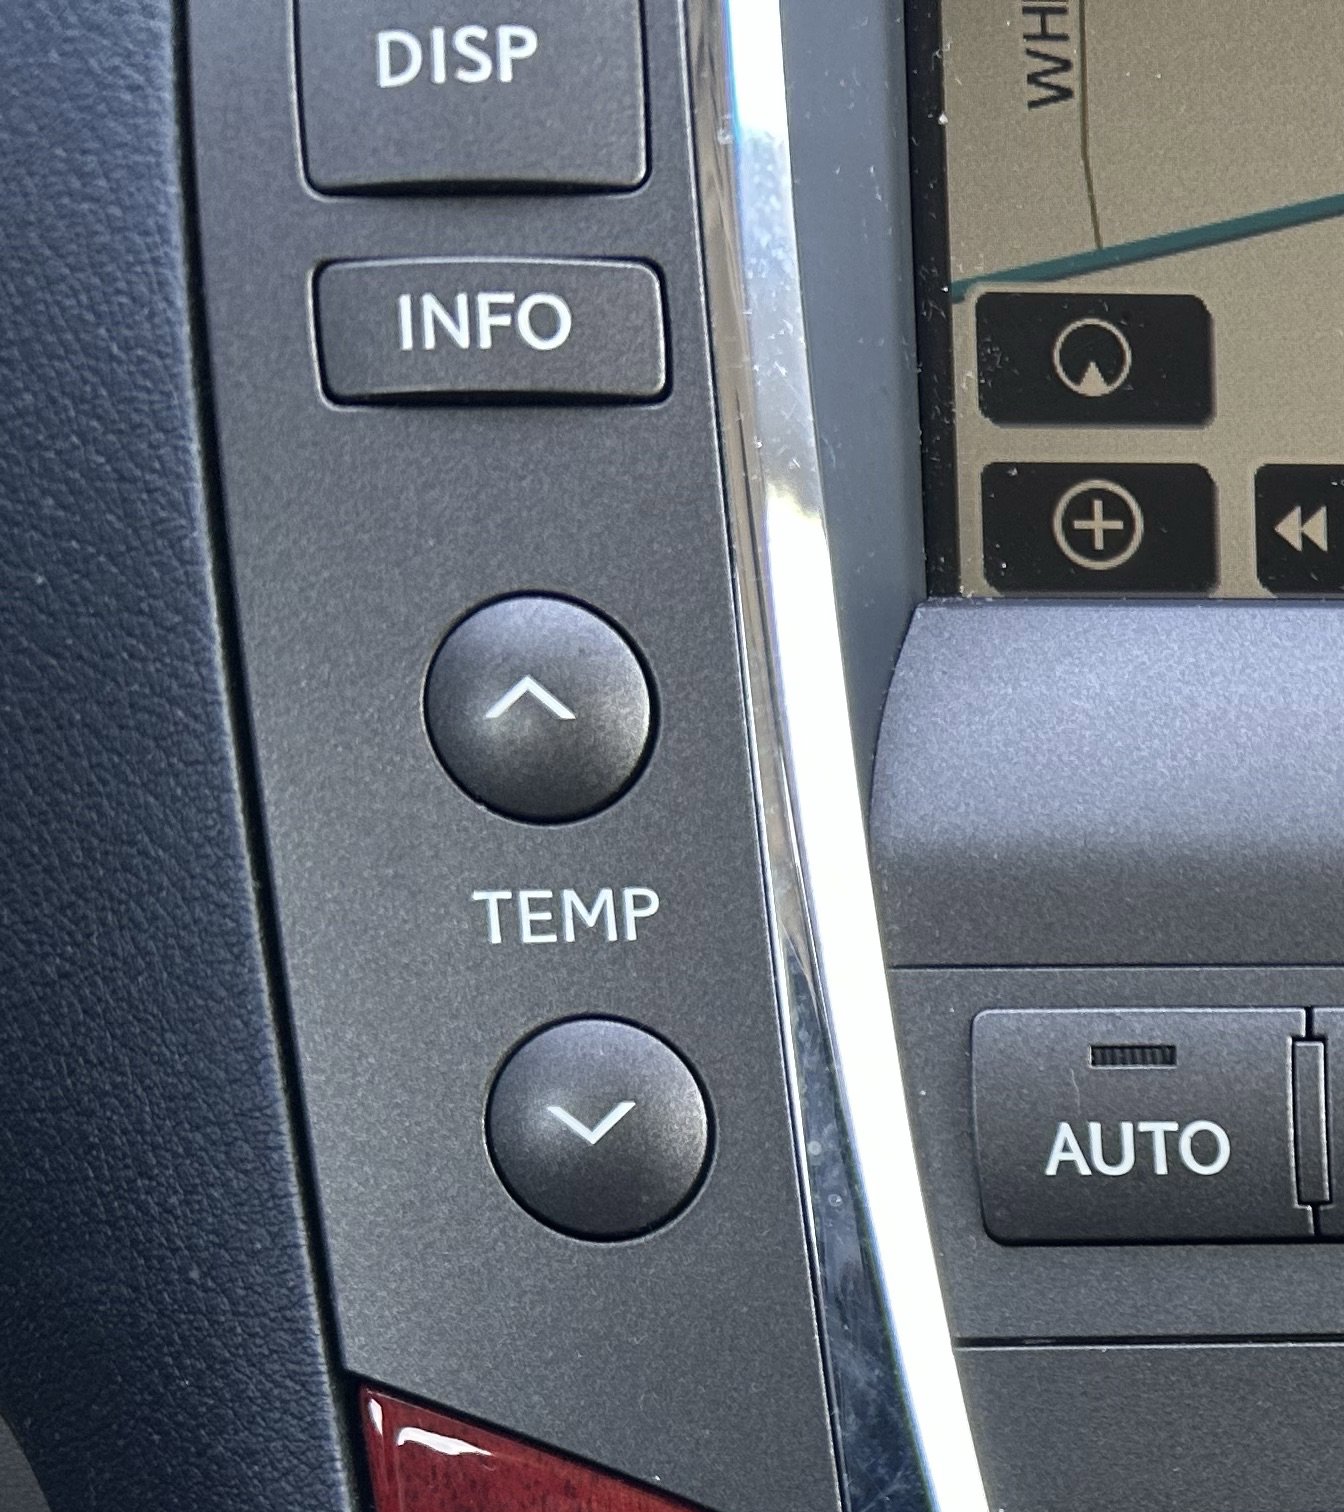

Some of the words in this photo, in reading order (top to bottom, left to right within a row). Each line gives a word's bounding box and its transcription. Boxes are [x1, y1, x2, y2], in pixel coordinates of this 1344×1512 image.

[377, 25, 538, 88] DISP
[1021, 0, 1074, 110] WH
[399, 292, 572, 351] INFO
[471, 887, 660, 944] TEMP
[1045, 1120, 1231, 1176] AUTO
